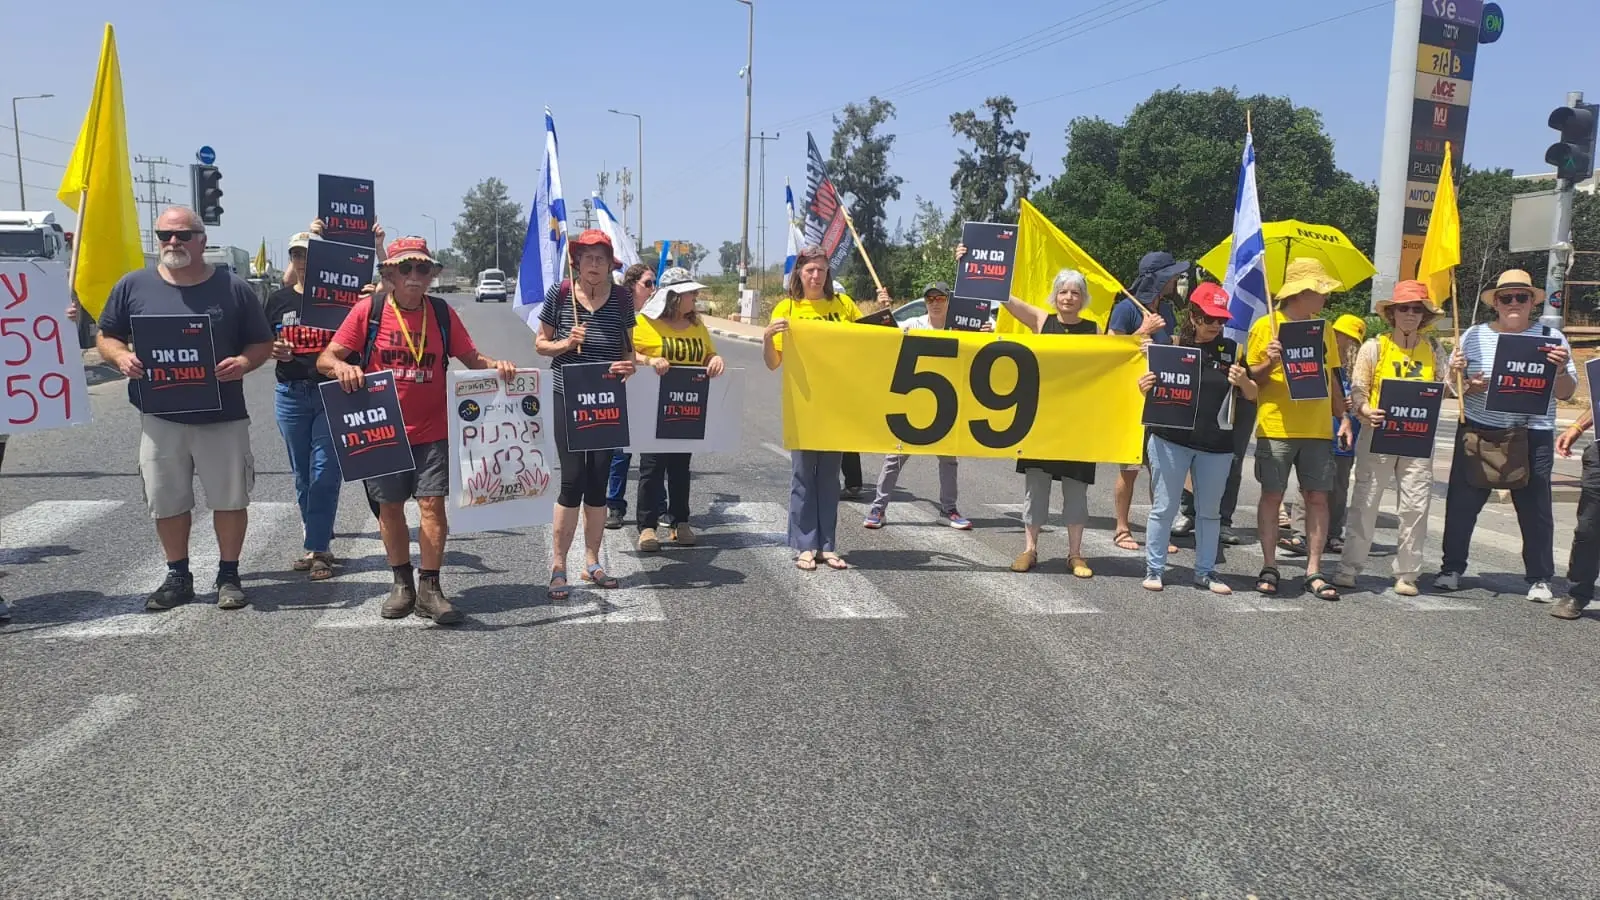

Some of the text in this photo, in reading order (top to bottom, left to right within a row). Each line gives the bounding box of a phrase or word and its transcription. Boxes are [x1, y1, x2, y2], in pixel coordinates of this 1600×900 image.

[1431, 77, 1456, 97] ACE
[1434, 106, 1448, 122] MJ
[330, 201, 365, 215] גם אני
[1296, 227, 1340, 245] NOW!
[972, 248, 1005, 262] גם אני
[320, 270, 359, 288] גם אני
[955, 315, 982, 329] גם אני
[0, 314, 64, 366] 59
[152, 349, 199, 363] גם אני
[661, 336, 704, 362] NOW
[1286, 346, 1315, 359] גם אני
[1506, 360, 1545, 375] גם אני
[1160, 371, 1191, 385] גם אני
[6, 372, 70, 424] 59
[577, 391, 615, 405] גם אני
[669, 391, 699, 402] גם אני
[885, 335, 1040, 448] 59
[343, 407, 388, 428] גם אני
[1390, 405, 1428, 419] גם אני
